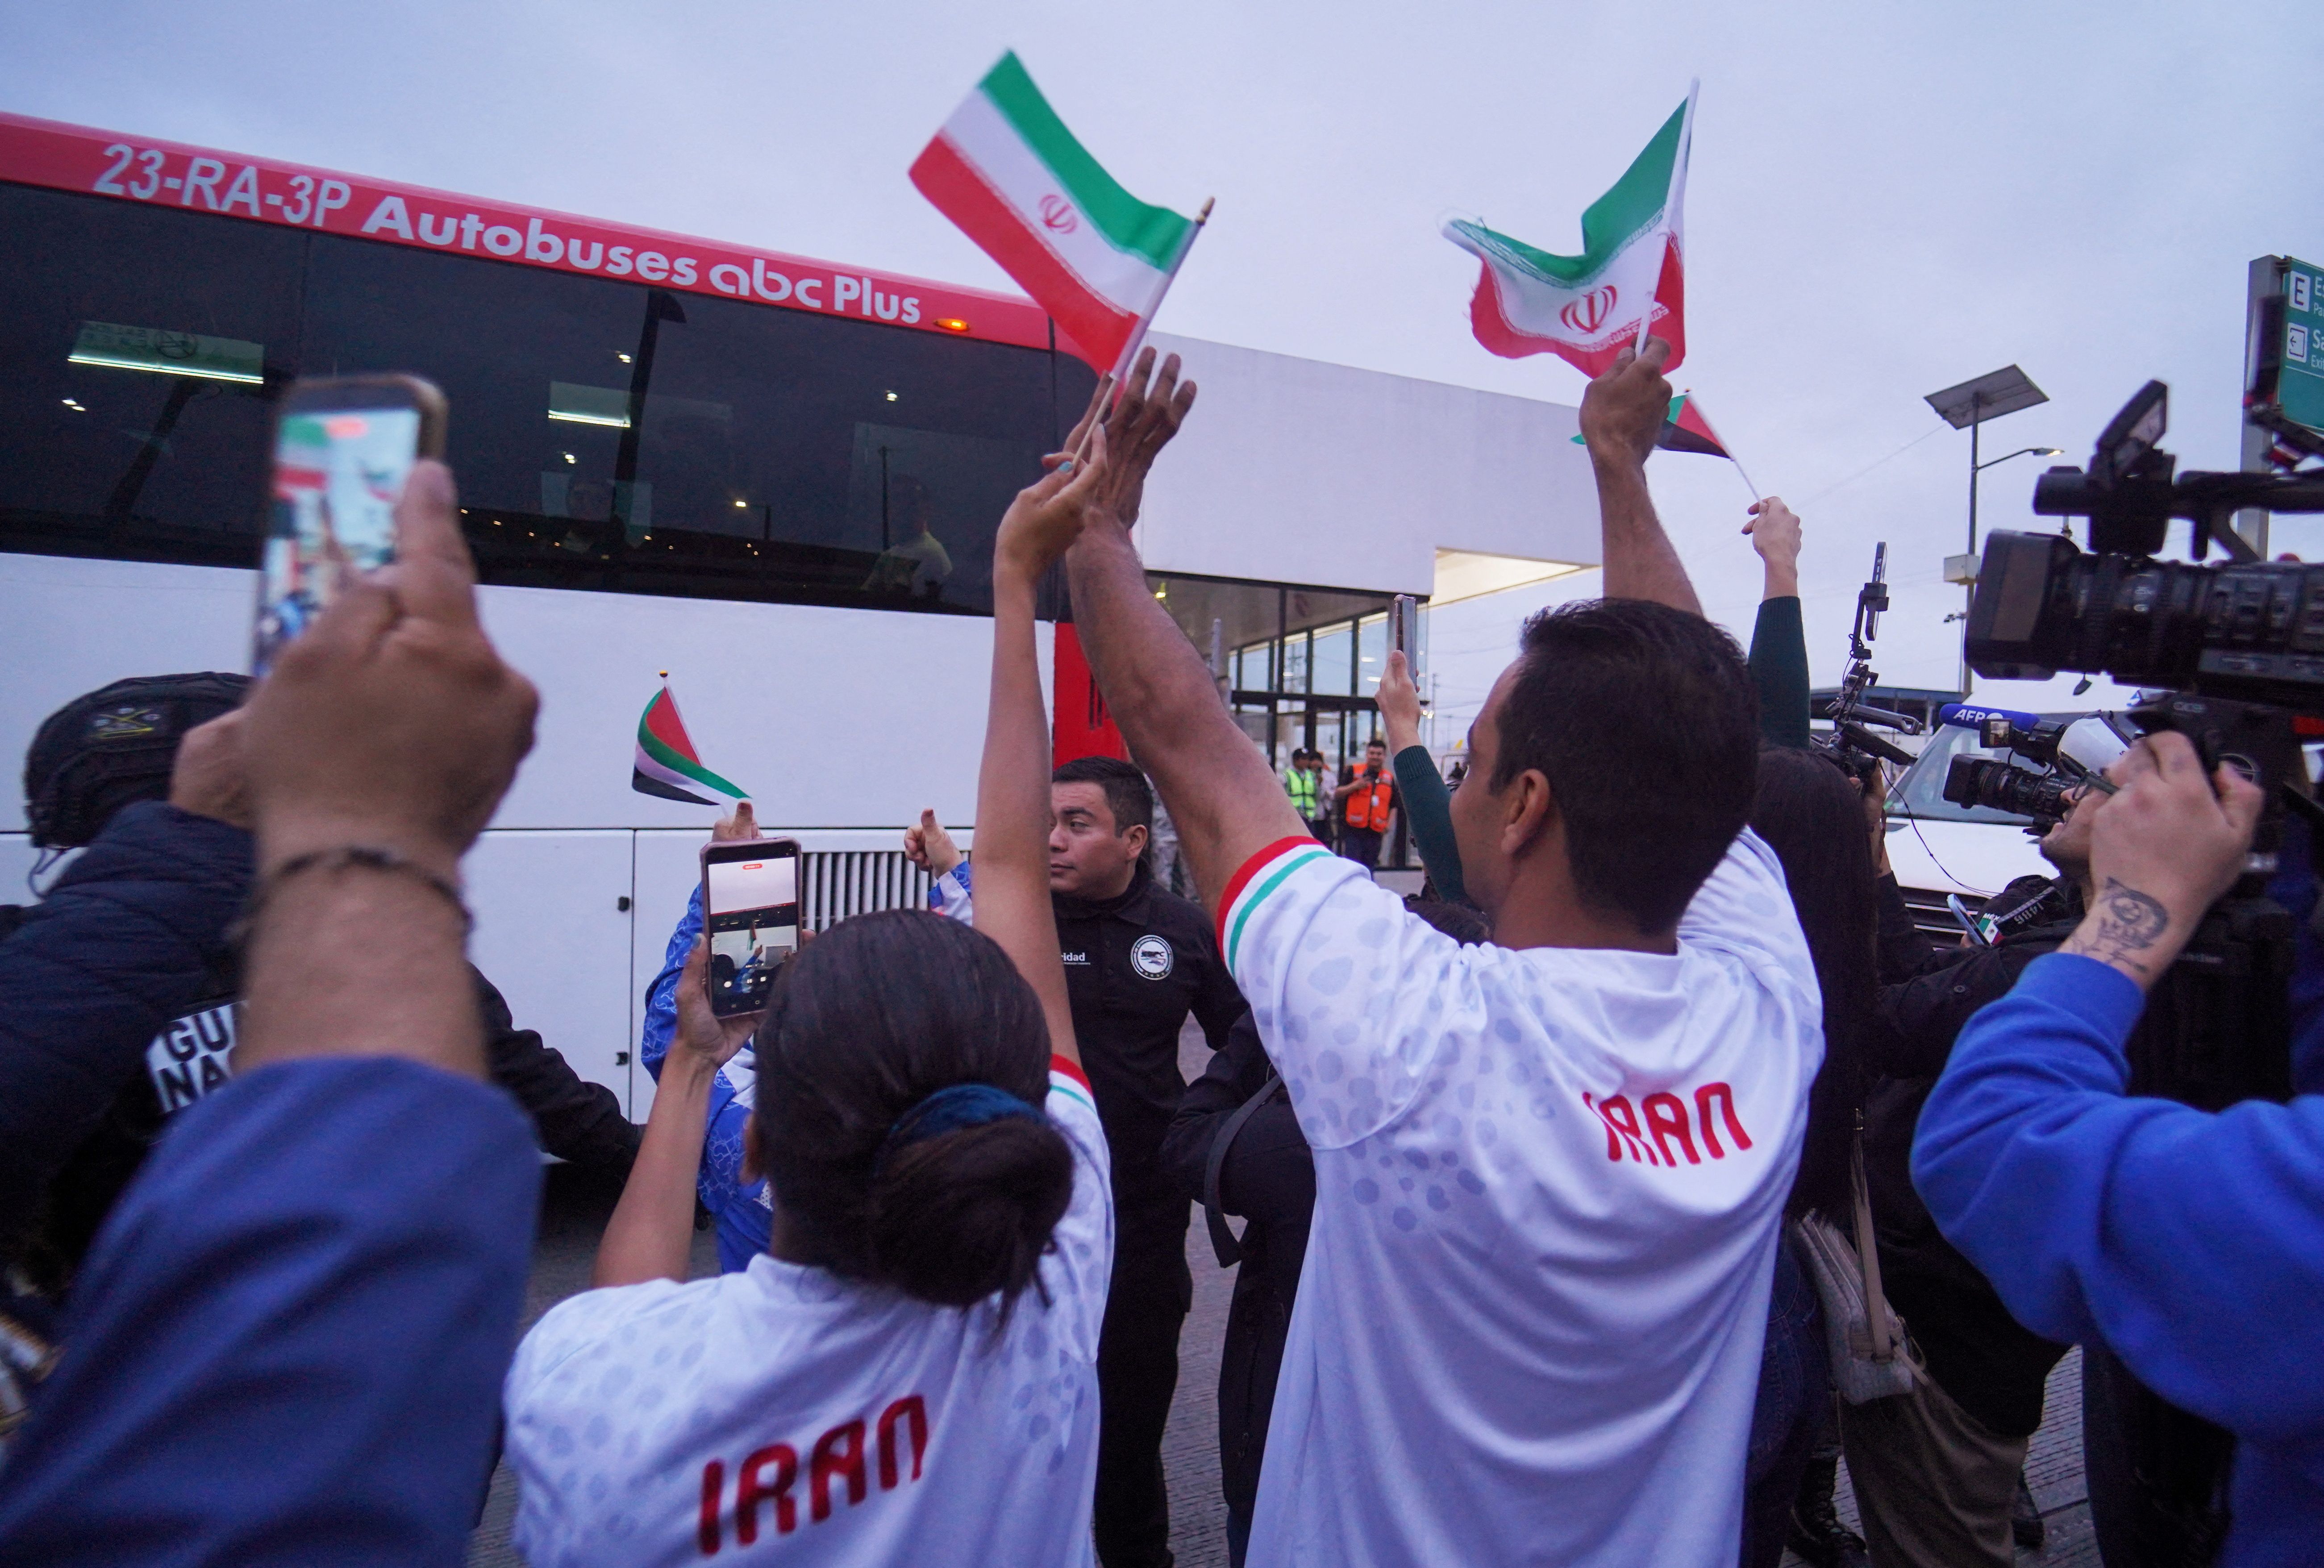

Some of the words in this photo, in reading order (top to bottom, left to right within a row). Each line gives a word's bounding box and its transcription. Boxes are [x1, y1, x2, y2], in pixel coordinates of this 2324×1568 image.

[92, 143, 351, 227] 23-RA-3P
[361, 195, 697, 286] Autobuses
[709, 258, 822, 308] abc
[834, 275, 921, 324] Plus
[1953, 709, 1986, 723] AFP
[1582, 1081, 1753, 1168] IRAN
[697, 1394, 928, 1556] IRAN
